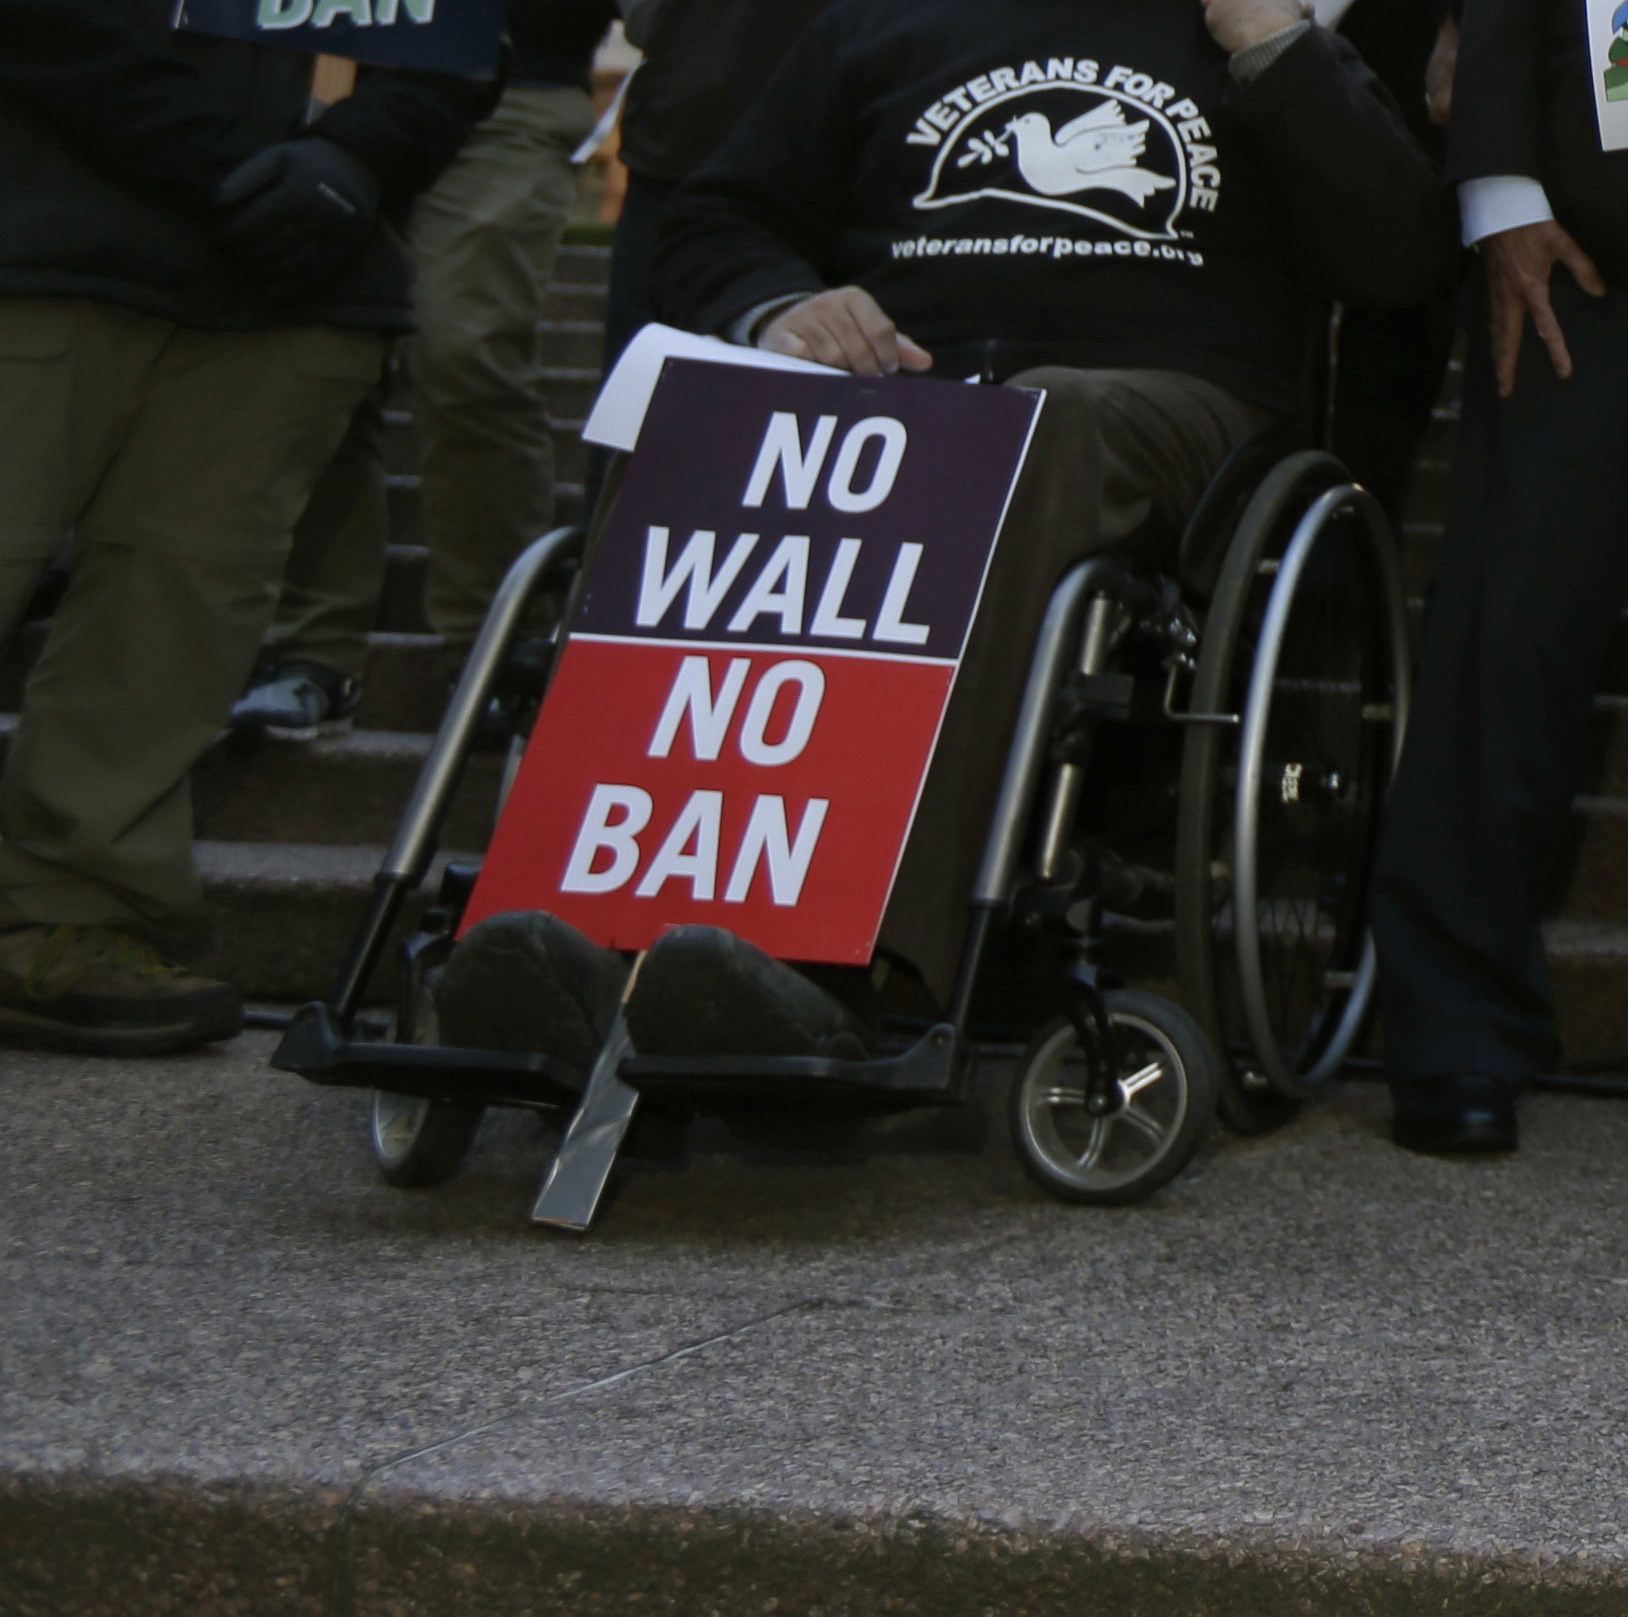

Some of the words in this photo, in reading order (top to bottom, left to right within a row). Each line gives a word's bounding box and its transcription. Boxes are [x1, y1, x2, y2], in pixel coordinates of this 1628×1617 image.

[906, 58, 1099, 147] VETERANS
[1104, 65, 1175, 109] FOR
[1165, 98, 1221, 212] PEACE
[892, 234, 1204, 266] veteransforpeace.org
[742, 411, 908, 513] NO
[635, 525, 930, 645] WALL
[647, 655, 826, 767] NO
[560, 783, 829, 907] BAN
